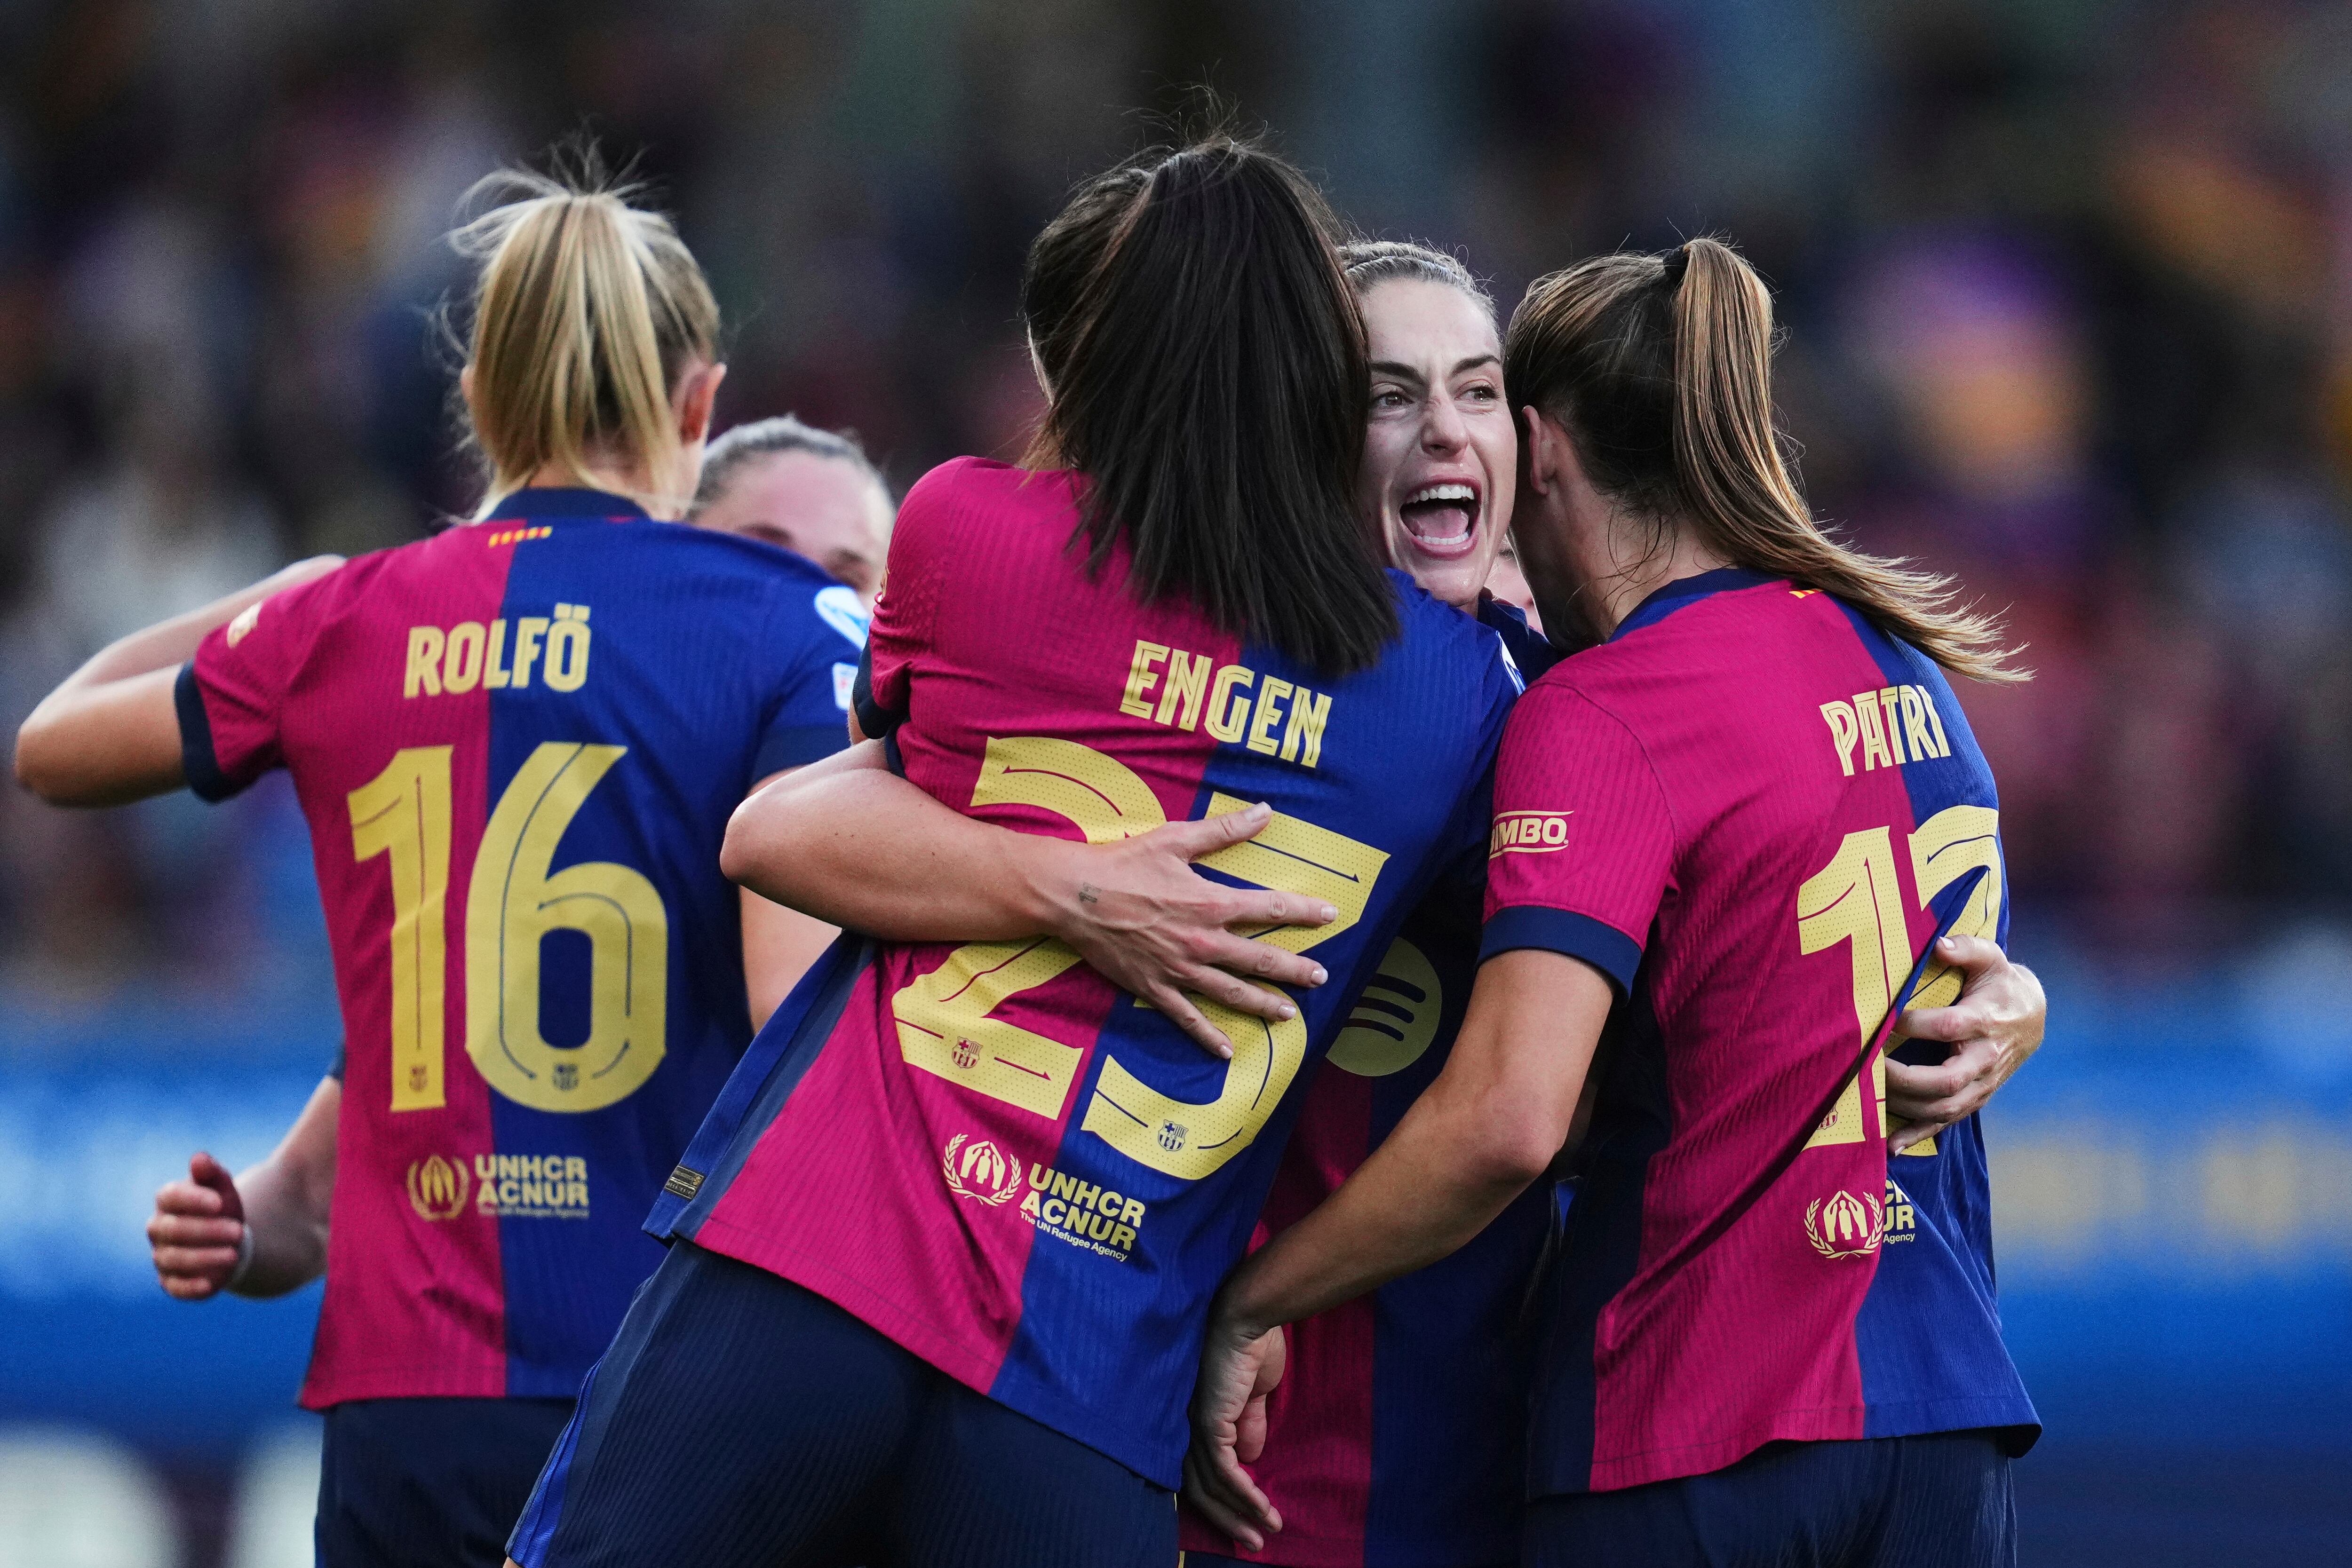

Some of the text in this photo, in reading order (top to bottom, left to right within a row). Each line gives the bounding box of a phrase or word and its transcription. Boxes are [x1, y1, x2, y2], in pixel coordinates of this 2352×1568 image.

[403, 603, 591, 699] ROLFÖ
[1119, 639, 1333, 768] ENGEN
[1819, 684, 1951, 776] PATRI
[347, 741, 668, 1114] 16
[892, 736, 1391, 1180] 23
[474, 1154, 588, 1180] UNHCR
[476, 1180, 589, 1206] ACNUR
[1028, 1163, 1145, 1228] UNHCR
[1019, 1190, 1136, 1251] ACNUR
[1020, 1211, 1128, 1262] The UN Refugee Agency
[1883, 1233, 1915, 1244] Agency
